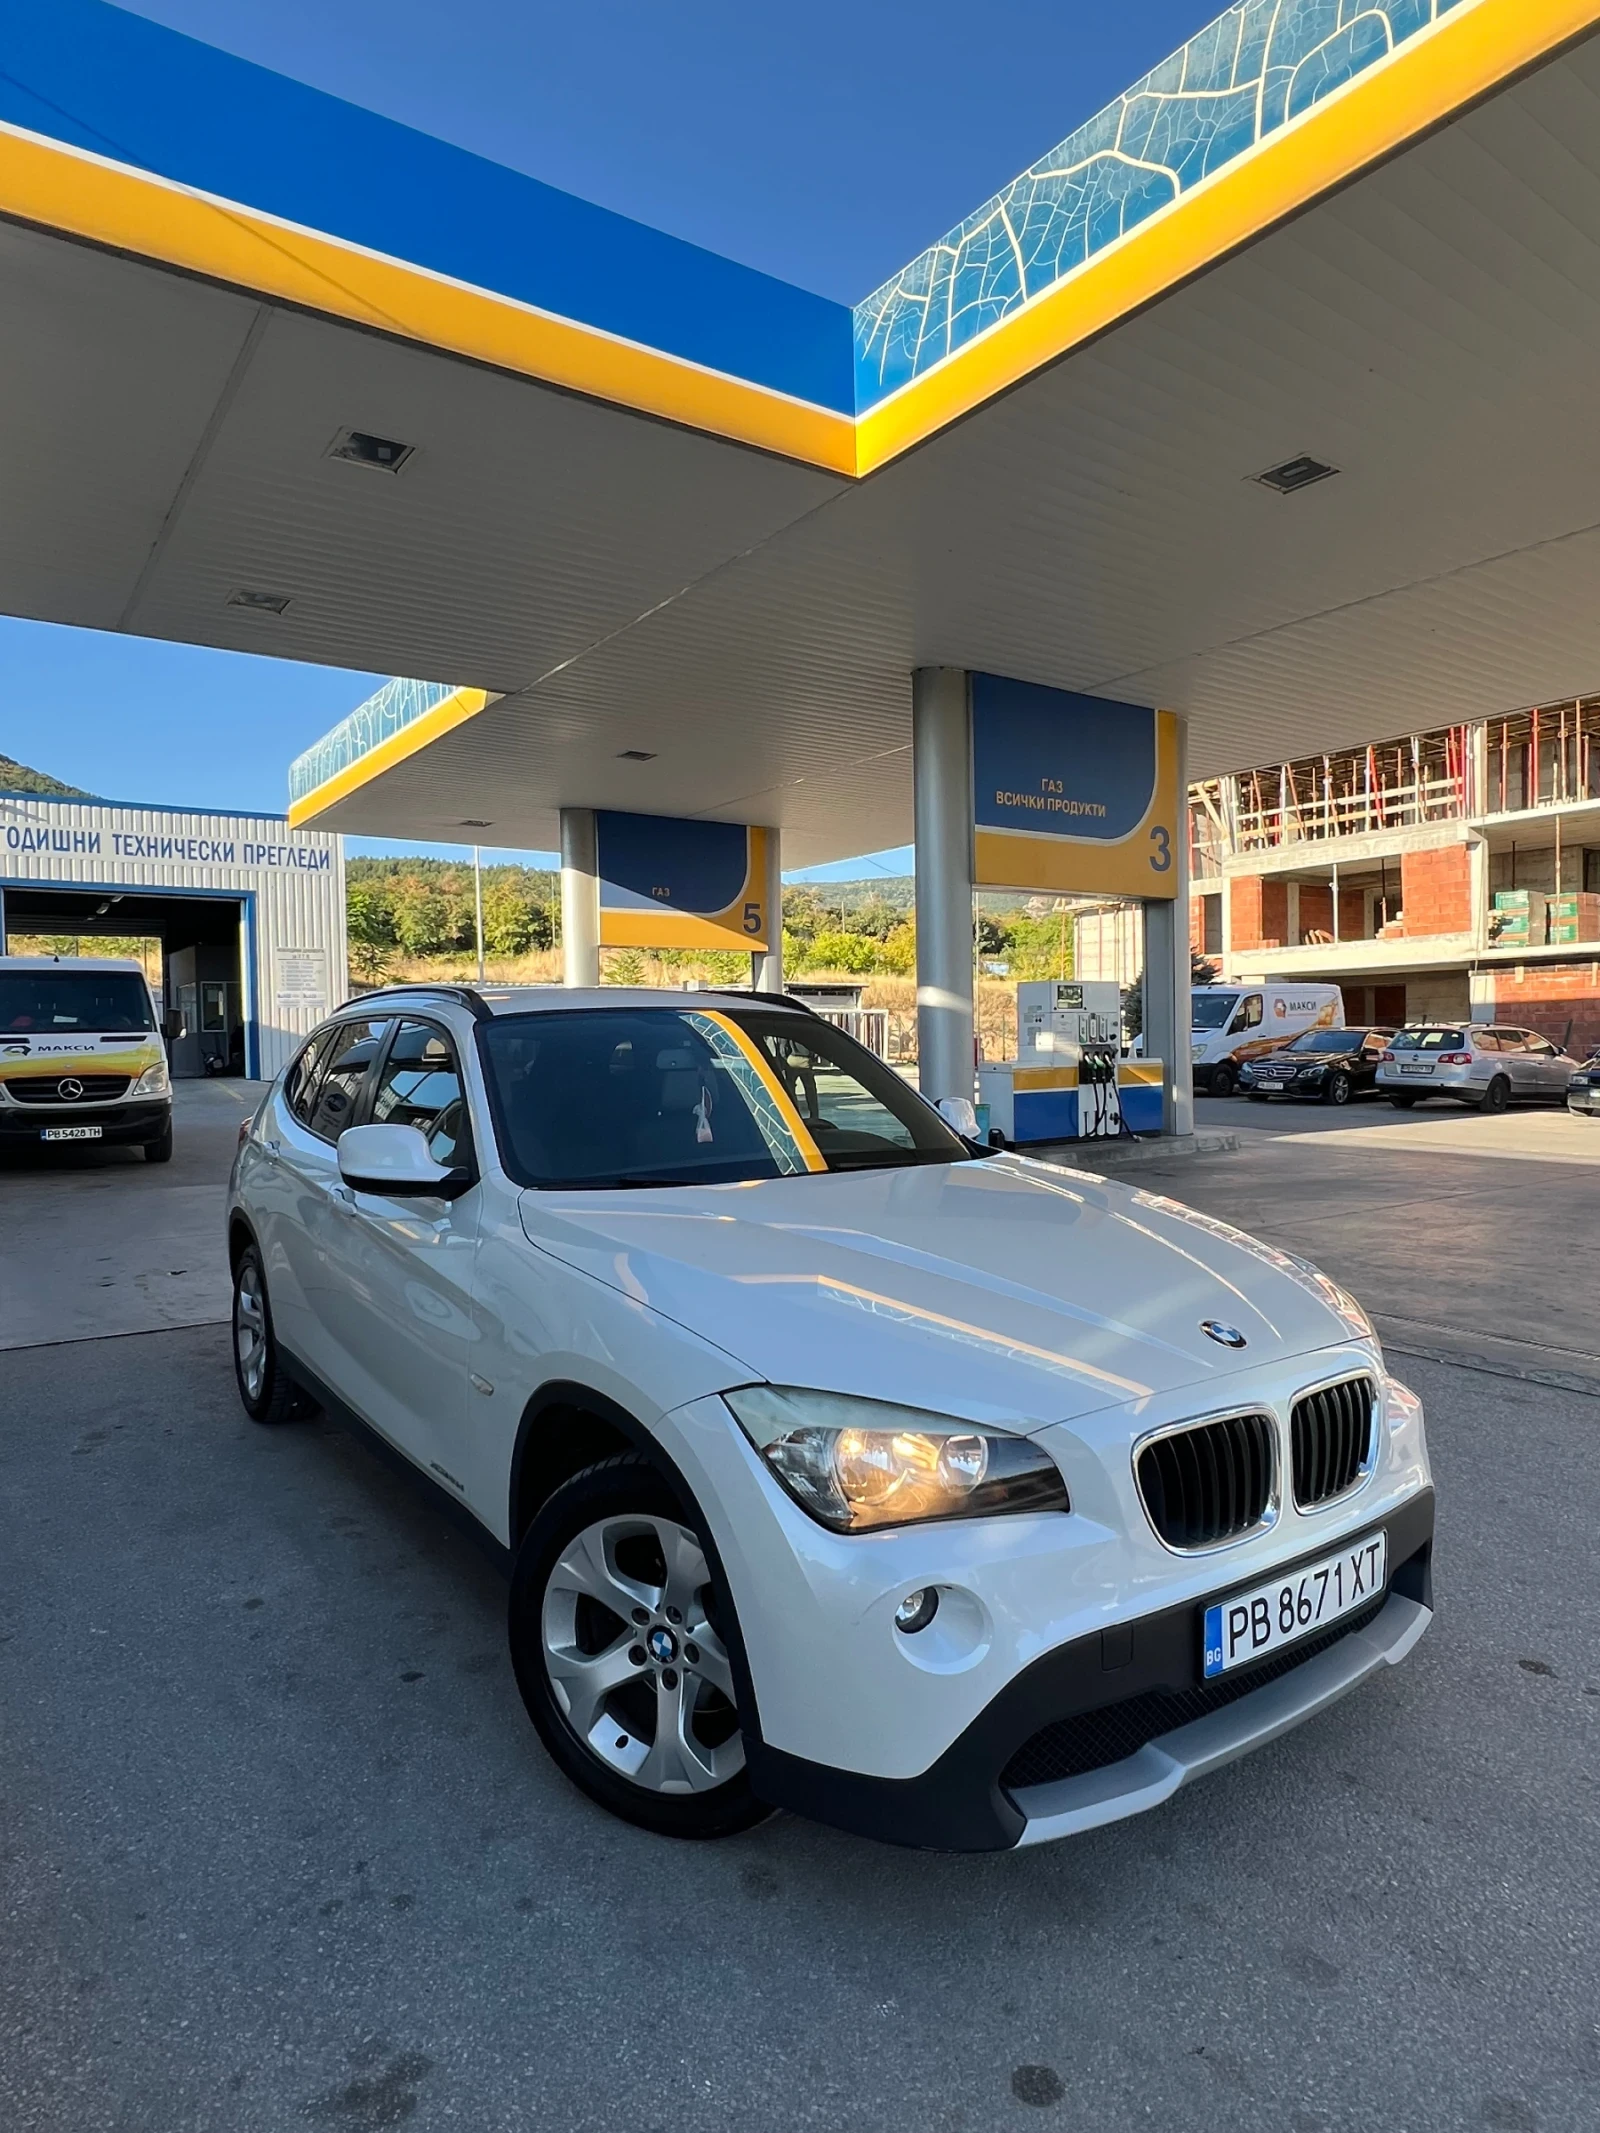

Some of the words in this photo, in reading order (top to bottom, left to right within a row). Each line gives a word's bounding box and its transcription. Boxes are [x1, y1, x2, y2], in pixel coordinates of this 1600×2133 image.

[1041, 778, 1064, 793] ГАЗ
[996, 790, 1045, 810] ВСИЧКИ
[1047, 798, 1106, 817] ПРОДУКТИ
[112, 833, 235, 863] ТЕХНИЧЕСКИ
[243, 843, 330, 871] ПРЕГЛЕДИ
[1150, 825, 1171, 872] 3
[652, 887, 670, 897] ГАЗ
[743, 902, 762, 934] 5
[1289, 1001, 1317, 1011] МАКСИ
[1229, 1597, 1271, 1659] PB
[1278, 1562, 1343, 1634] 8671
[1350, 1541, 1381, 1601] XT
[1206, 1647, 1221, 1666] BG
